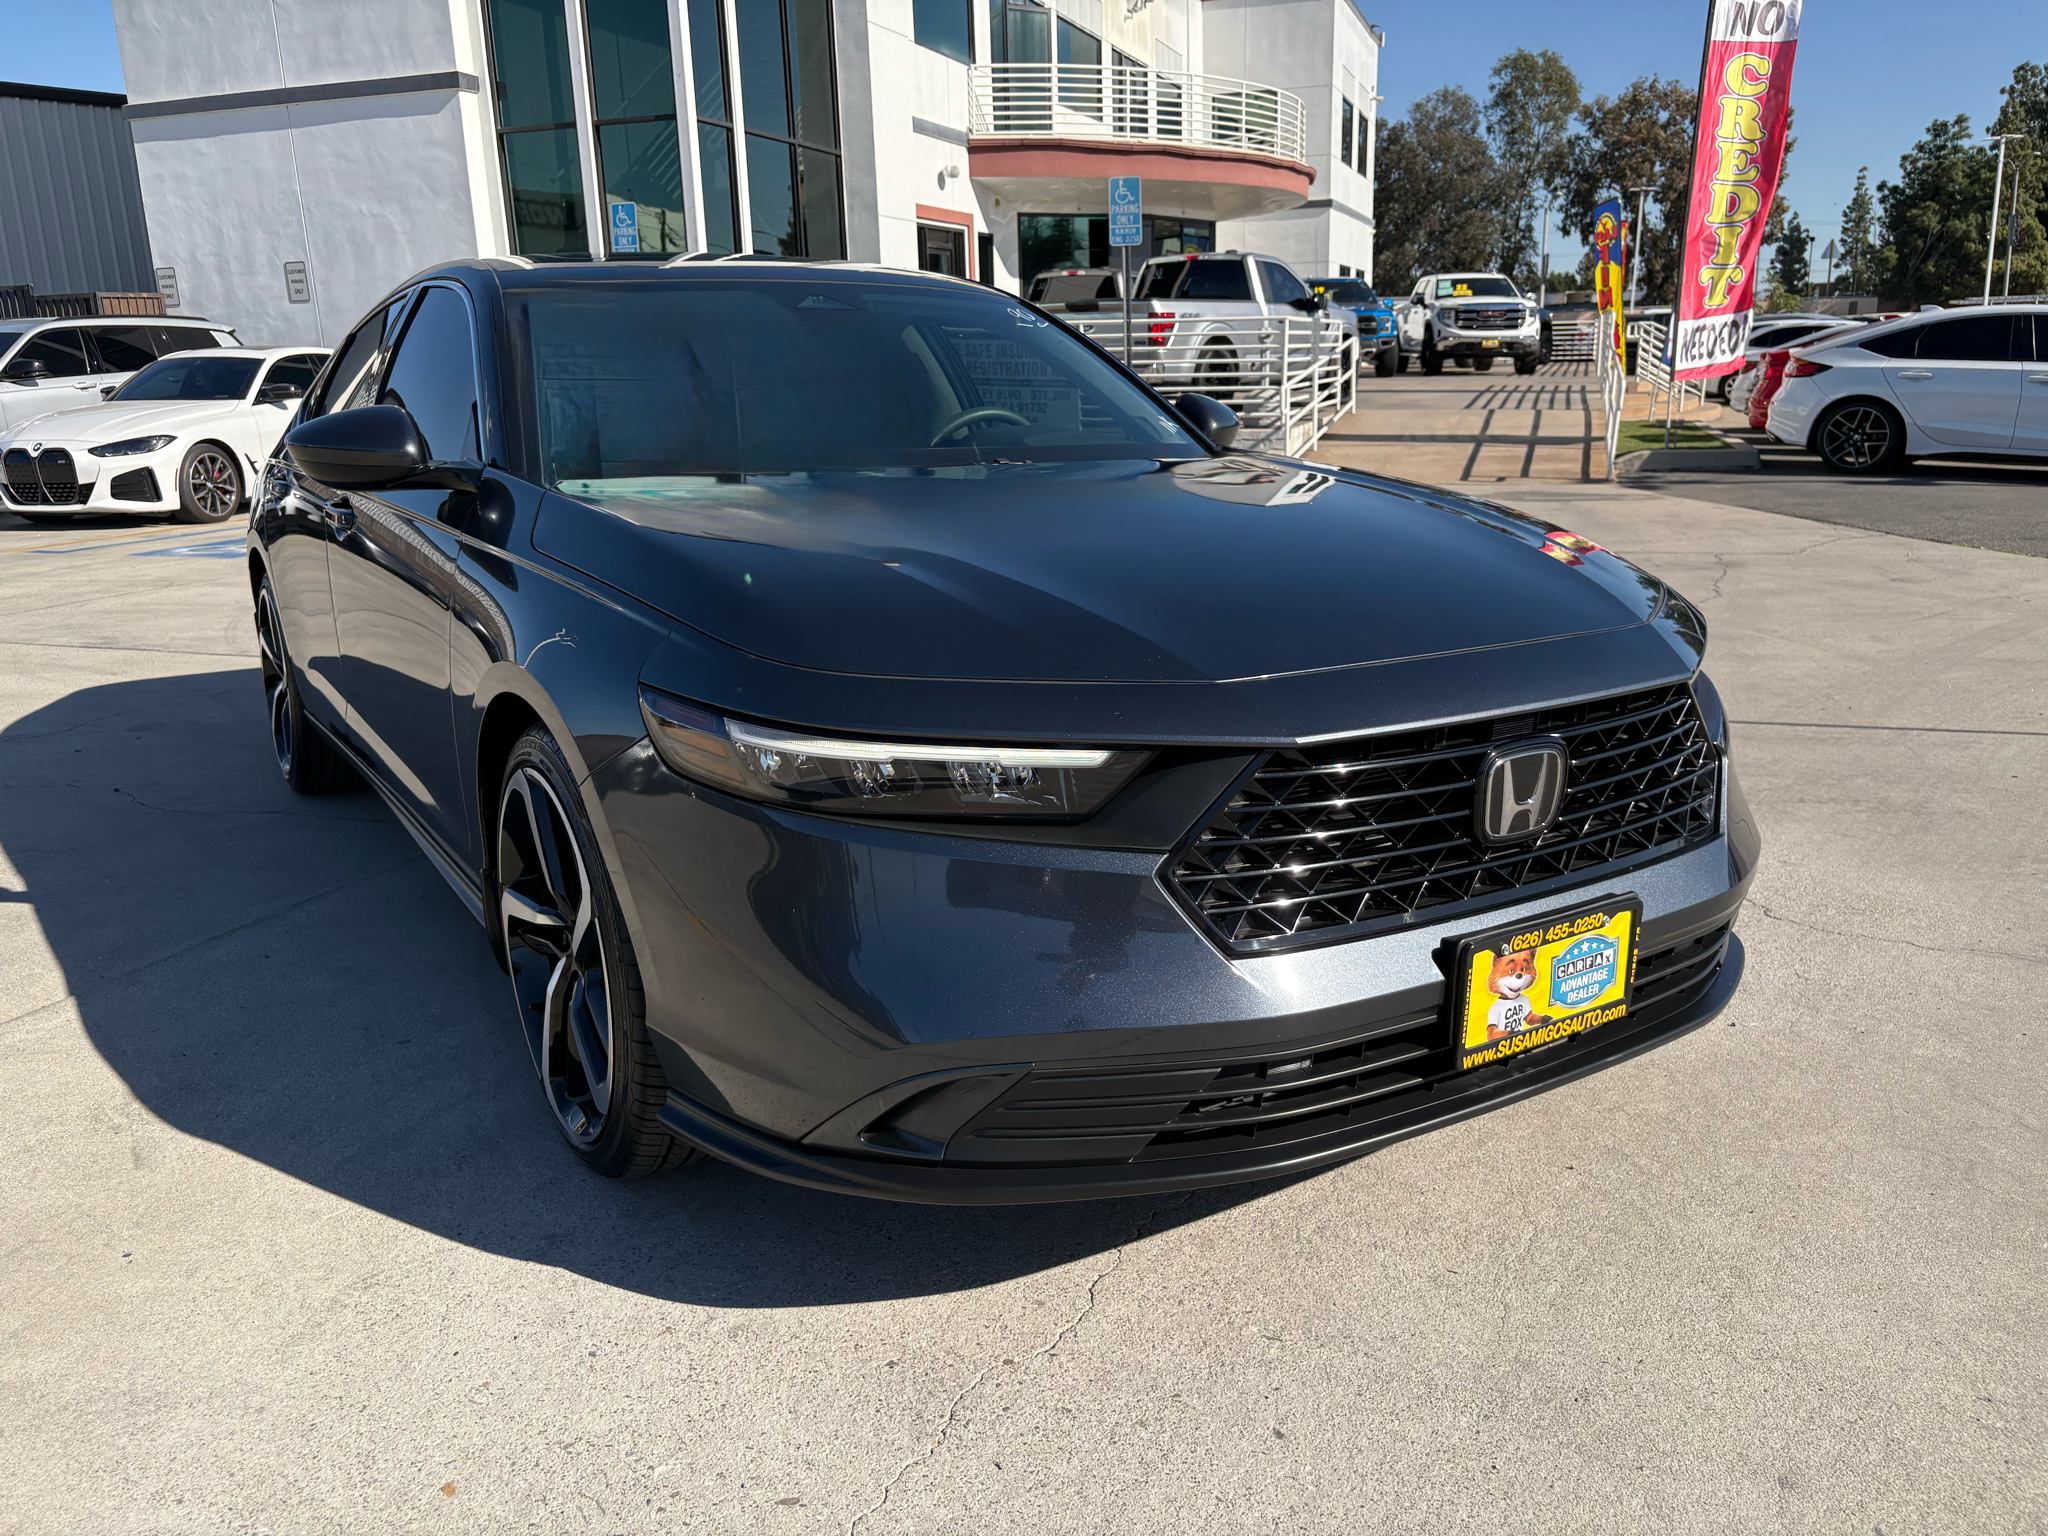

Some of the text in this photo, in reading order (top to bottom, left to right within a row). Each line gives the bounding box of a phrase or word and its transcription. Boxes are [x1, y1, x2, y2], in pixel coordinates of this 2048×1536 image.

[1730, 0, 1785, 36] NO
[1700, 53, 1771, 308] CREDIT
[1111, 204, 1139, 214] PARKING
[1116, 215, 1134, 225] ONLY
[613, 227, 636, 236] PARKING
[618, 236, 633, 245] ONLY
[965, 343, 992, 358] SAFE
[1017, 402, 1048, 413] 91732
[1510, 912, 1604, 953] (626) 455-0250
[1557, 951, 1612, 979] CARFAX
[1560, 967, 1609, 994] ADVANTAGE
[1567, 983, 1599, 1004] DEALER
[1504, 1004, 1523, 1021] CAR
[1504, 1016, 1523, 1031] FOX
[1463, 1004, 1626, 1069] www.SUSAMIGOSAUTO.com
